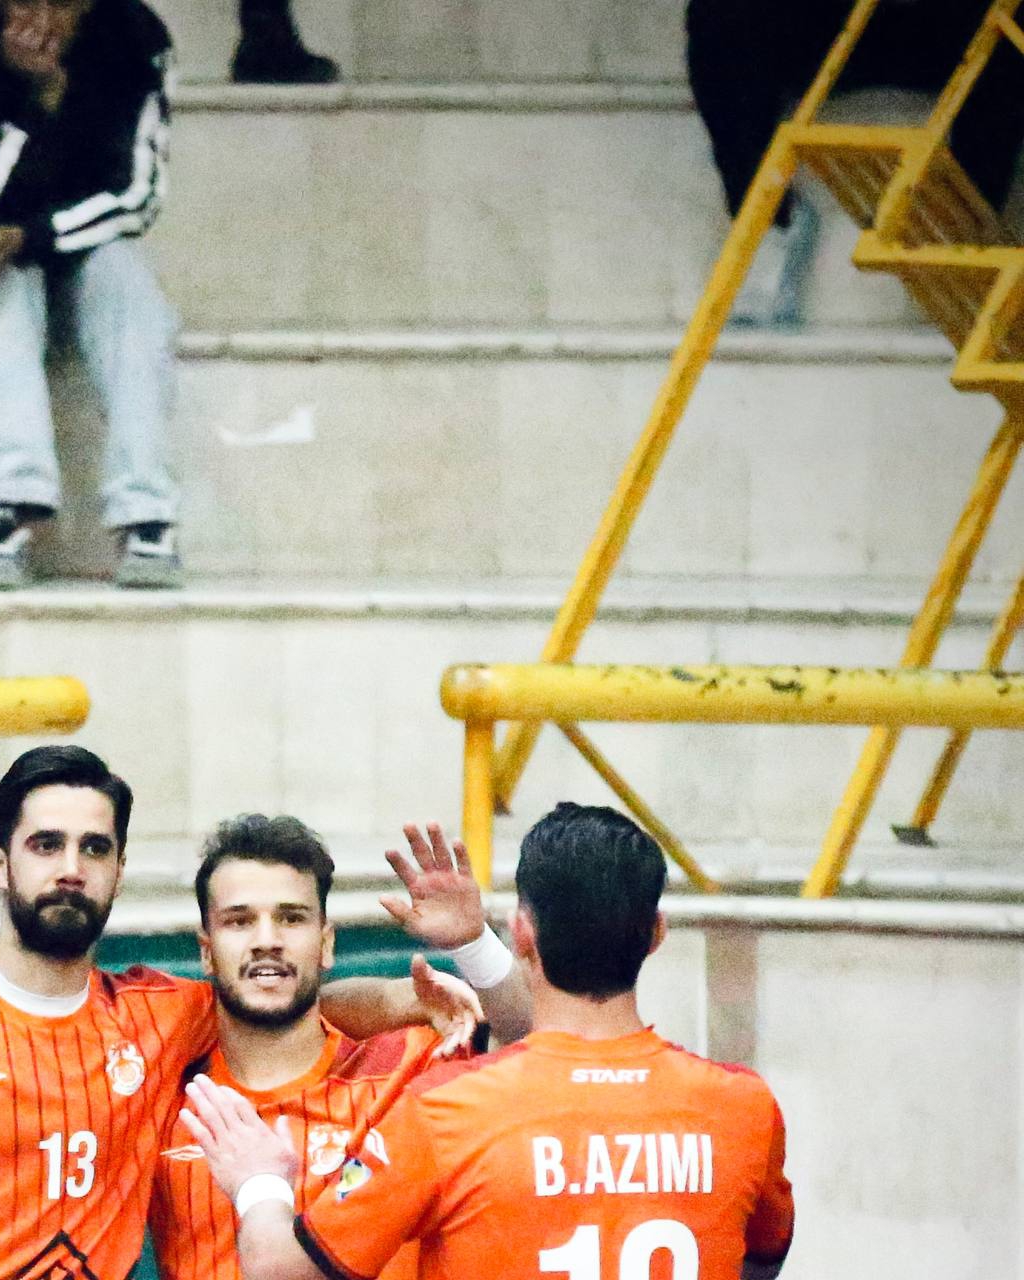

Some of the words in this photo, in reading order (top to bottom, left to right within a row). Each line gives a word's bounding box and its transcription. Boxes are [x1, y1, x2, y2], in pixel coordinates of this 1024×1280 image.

[571, 1068, 650, 1083] START
[39, 1131, 98, 1200] 13
[532, 1133, 713, 1196] B.AZIMI
